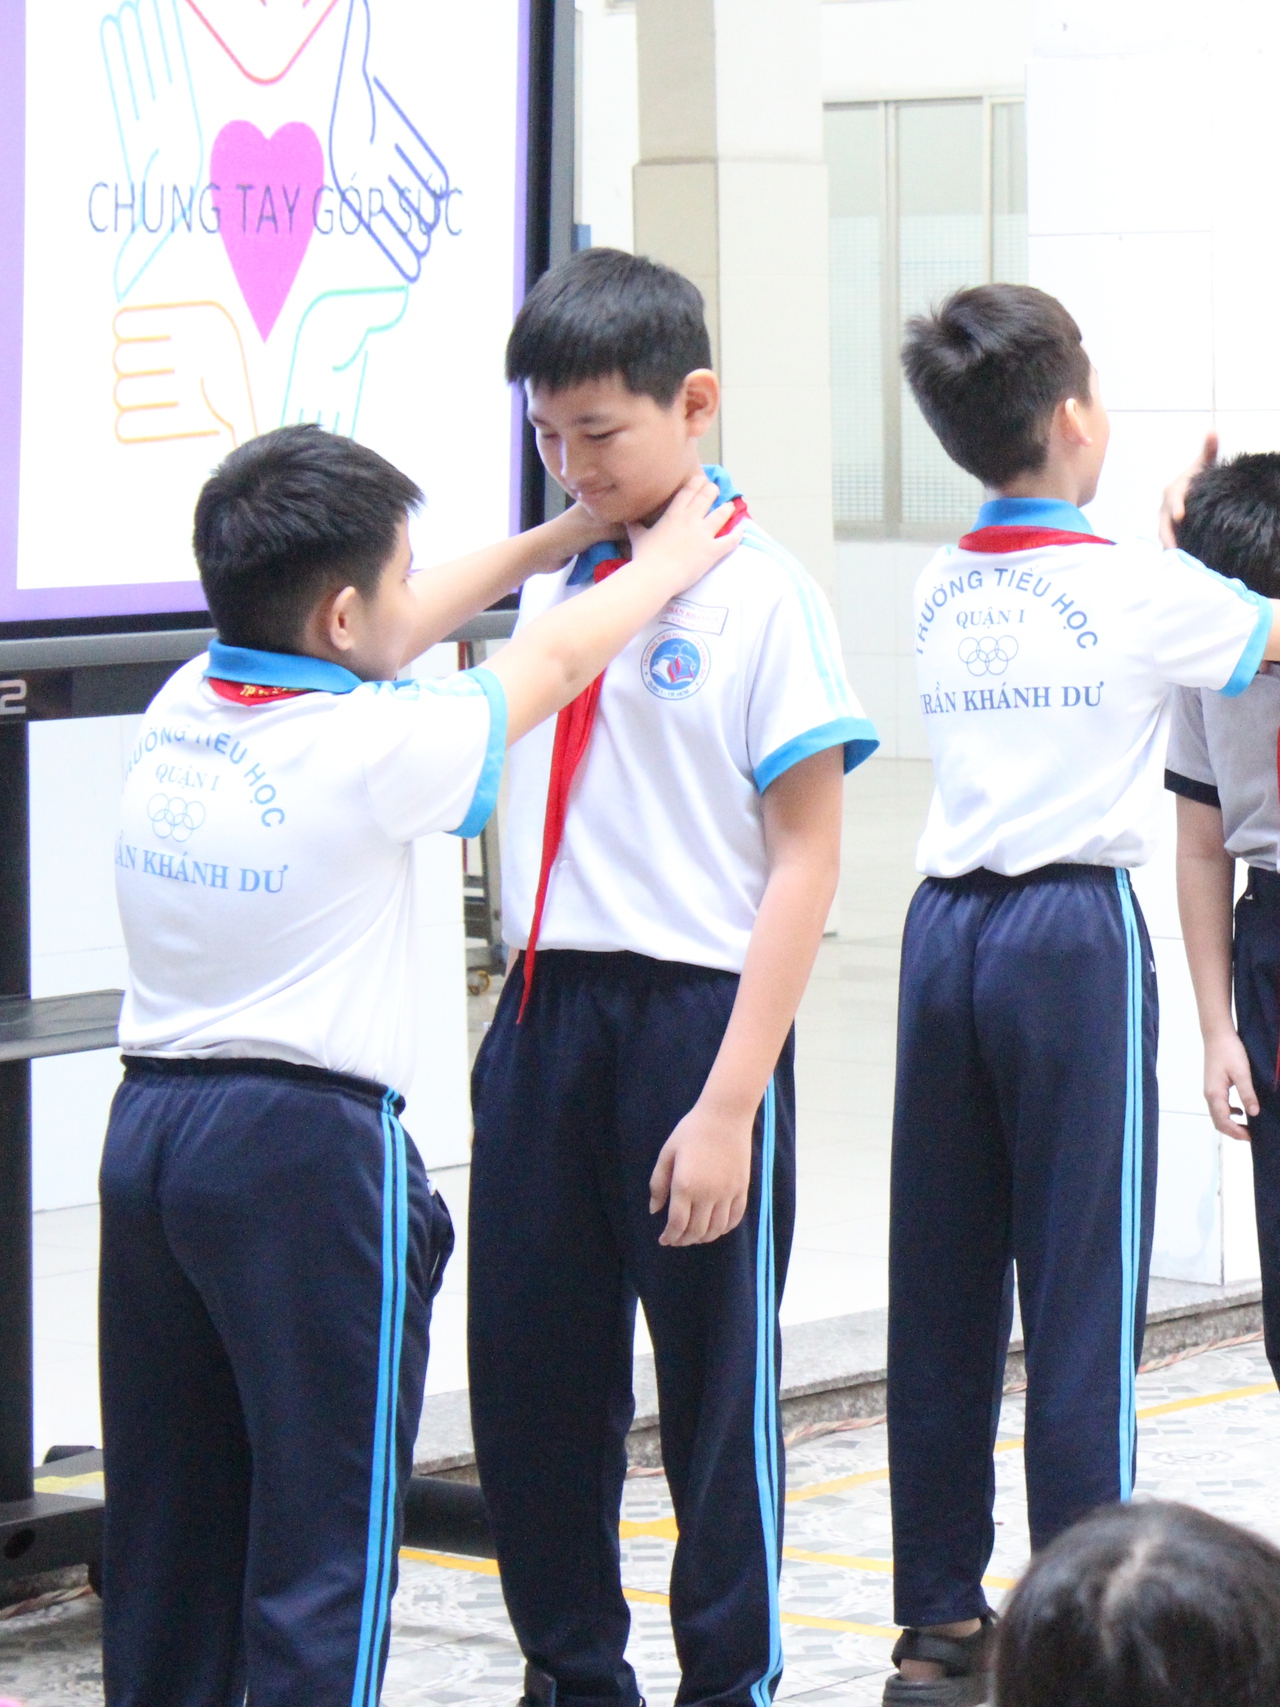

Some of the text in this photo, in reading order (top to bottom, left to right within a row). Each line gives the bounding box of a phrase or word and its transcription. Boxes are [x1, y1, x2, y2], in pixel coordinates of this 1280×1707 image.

[88, 181, 222, 234] CHUNG
[236, 183, 301, 235] TAY
[312, 171, 385, 236] GÓP
[956, 606, 1012, 629] QUẬN
[1050, 592, 1099, 650] HỌC
[963, 681, 1052, 711] KHÁNH
[1061, 680, 1105, 708] DƯ
[156, 763, 208, 790] QUẬN
[243, 762, 286, 828] HỌC
[142, 851, 230, 890] KHÁNH
[238, 863, 289, 894] DƯ
